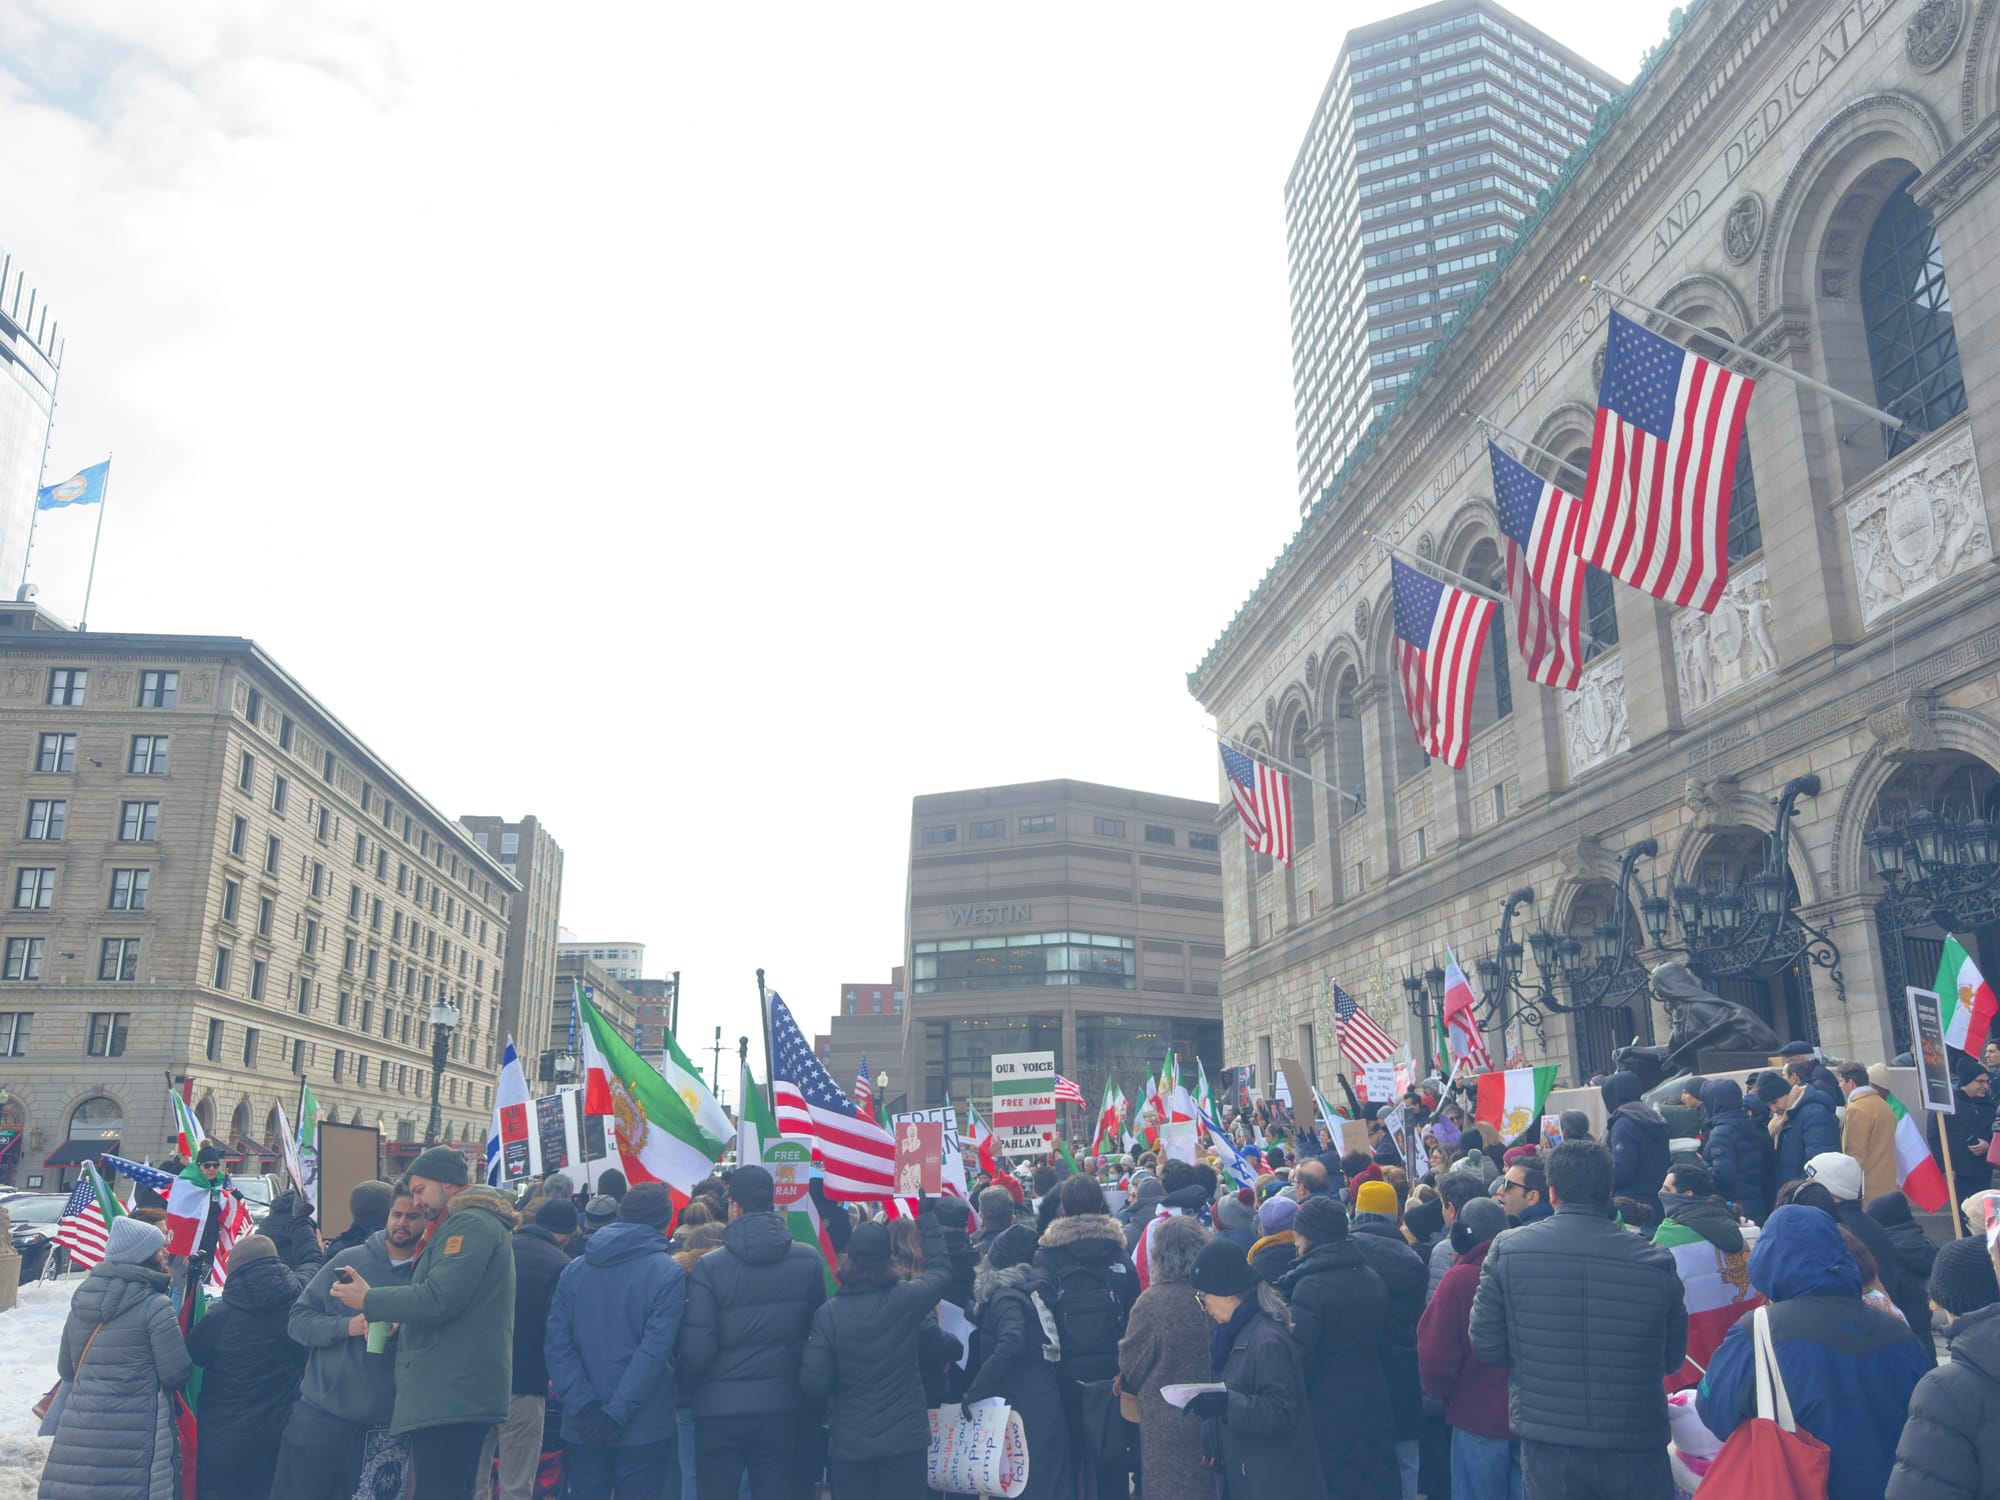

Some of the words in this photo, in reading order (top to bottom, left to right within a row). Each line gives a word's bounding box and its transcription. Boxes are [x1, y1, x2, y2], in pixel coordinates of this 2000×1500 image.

[1328, 574, 1352, 615] CITY
[1357, 554, 1371, 581] OF
[1376, 493, 1425, 562] BOSTON
[1433, 443, 1471, 501] BUILT
[1512, 357, 1549, 409] THE
[1560, 261, 1634, 362] PEOPLE
[1652, 189, 1701, 262] AND
[1724, 0, 1890, 180] DEDICATE
[946, 903, 1032, 927] WESTIN
[996, 1064, 1015, 1073] OUR
[1023, 1062, 1053, 1072] VOICE
[1001, 1099, 1024, 1107] FREE
[1029, 1097, 1050, 1105] IRAN
[1013, 1125, 1037, 1135] REZA
[774, 1151, 800, 1160] FREE
[775, 1186, 797, 1195] RAN
